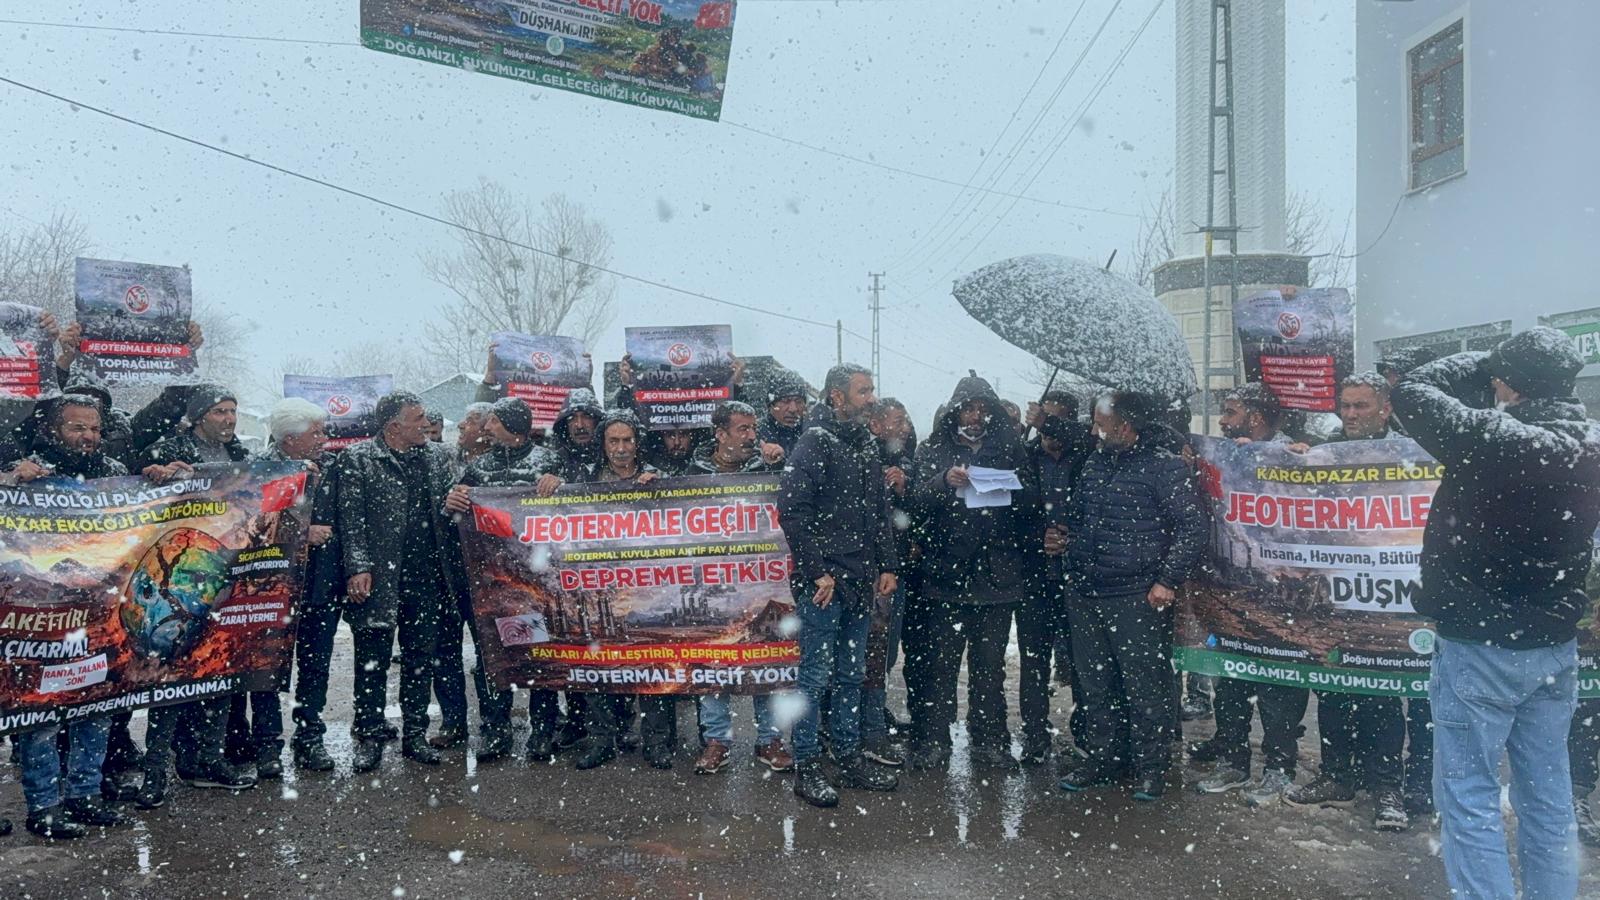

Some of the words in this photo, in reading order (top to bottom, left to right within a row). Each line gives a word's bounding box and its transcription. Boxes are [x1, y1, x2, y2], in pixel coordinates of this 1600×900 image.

[627, 0, 662, 25] YOK
[520, 10, 594, 40] DÜŞMANDIR!
[385, 39, 459, 66] DOĞAMIZI,
[463, 56, 540, 82] SUYUMUZU,
[543, 73, 629, 100] GELECEĞİMİZİ
[642, 391, 698, 400] JEOTERMALE
[698, 389, 723, 398] HAYIR
[650, 402, 716, 413] TOPRAĞIMIZI
[1257, 467, 1379, 483] KARGAPAZAR
[33, 491, 109, 509] EKOLOJİ
[112, 479, 212, 506] PLATFORMU
[562, 493, 600, 504] EKOLOJİ
[600, 491, 653, 502] PLATFORMU
[660, 486, 722, 498] KARGAPAZAR
[723, 483, 763, 493] EKOLOJİ
[56, 512, 136, 533] EKOLOJİ
[139, 501, 227, 524] PLATFORMU
[519, 508, 683, 543] JEOTERMALE
[686, 499, 762, 538] GEÇİT
[1224, 491, 1433, 531] JEOTERMALE
[564, 551, 619, 561] JEOTERMAL
[620, 548, 676, 559] KUYULARIN
[678, 545, 706, 556] AKTİF
[708, 545, 727, 554] FAY
[729, 543, 780, 553] HATTINDA
[1260, 546, 1307, 563] İnsana,
[1310, 549, 1375, 567] Hayvana,
[560, 563, 696, 592] DEPREME
[220, 614, 247, 625] ZARAR
[248, 611, 278, 623] VERME!
[4, 637, 89, 664] ÇIKARMA!
[531, 647, 579, 659] FAYLARI
[681, 648, 738, 659] DEPREME
[742, 646, 788, 659] NEDEN
[1220, 637, 1242, 650] Temiz
[1243, 641, 1262, 654] Suya
[1343, 654, 1375, 666] Doğayı
[44, 669, 76, 680] RANTA,
[567, 668, 686, 684] JEOTERMALE
[691, 666, 745, 686] GEÇİT
[750, 666, 799, 684] YOK!
[1224, 659, 1304, 684] DOĞAMIZI,
[1309, 671, 1406, 693] SUYUMUZU,
[66, 691, 150, 719] DEPREMİNE
[154, 678, 232, 702] DOKUNMA!
